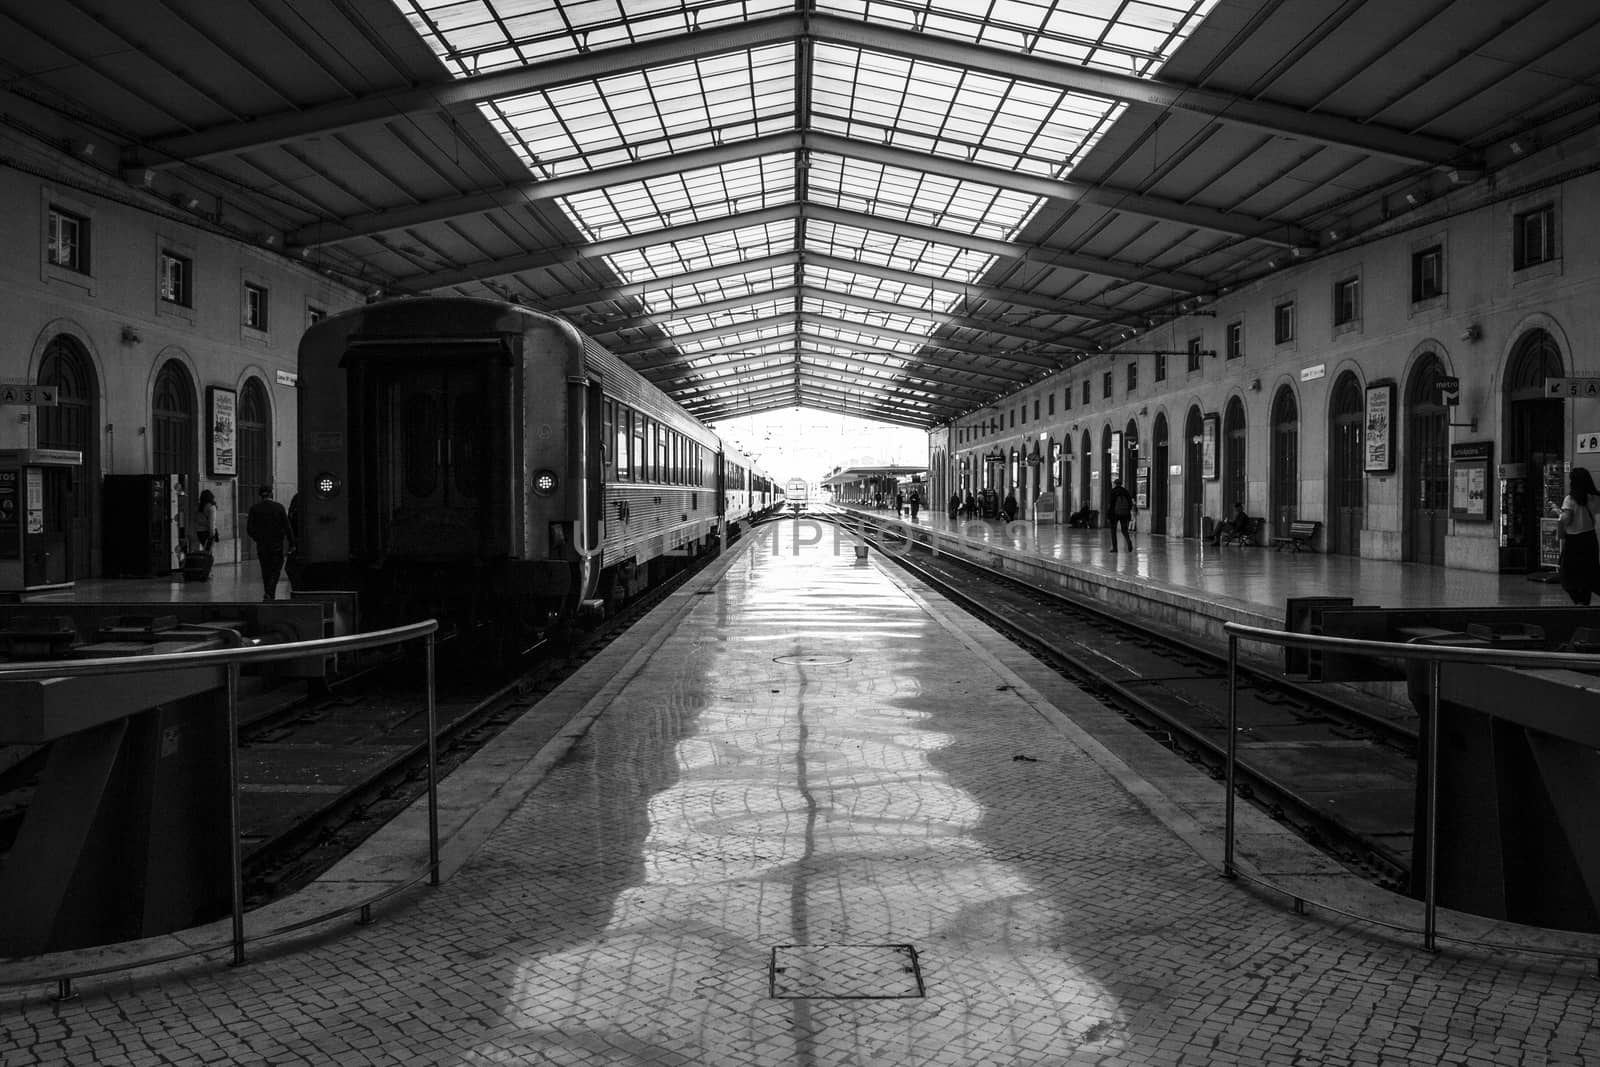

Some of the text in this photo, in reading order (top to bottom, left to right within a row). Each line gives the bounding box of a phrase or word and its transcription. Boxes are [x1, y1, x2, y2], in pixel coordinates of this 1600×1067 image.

[1588, 385, 1596, 393] A
[5, 391, 32, 402] A 3
